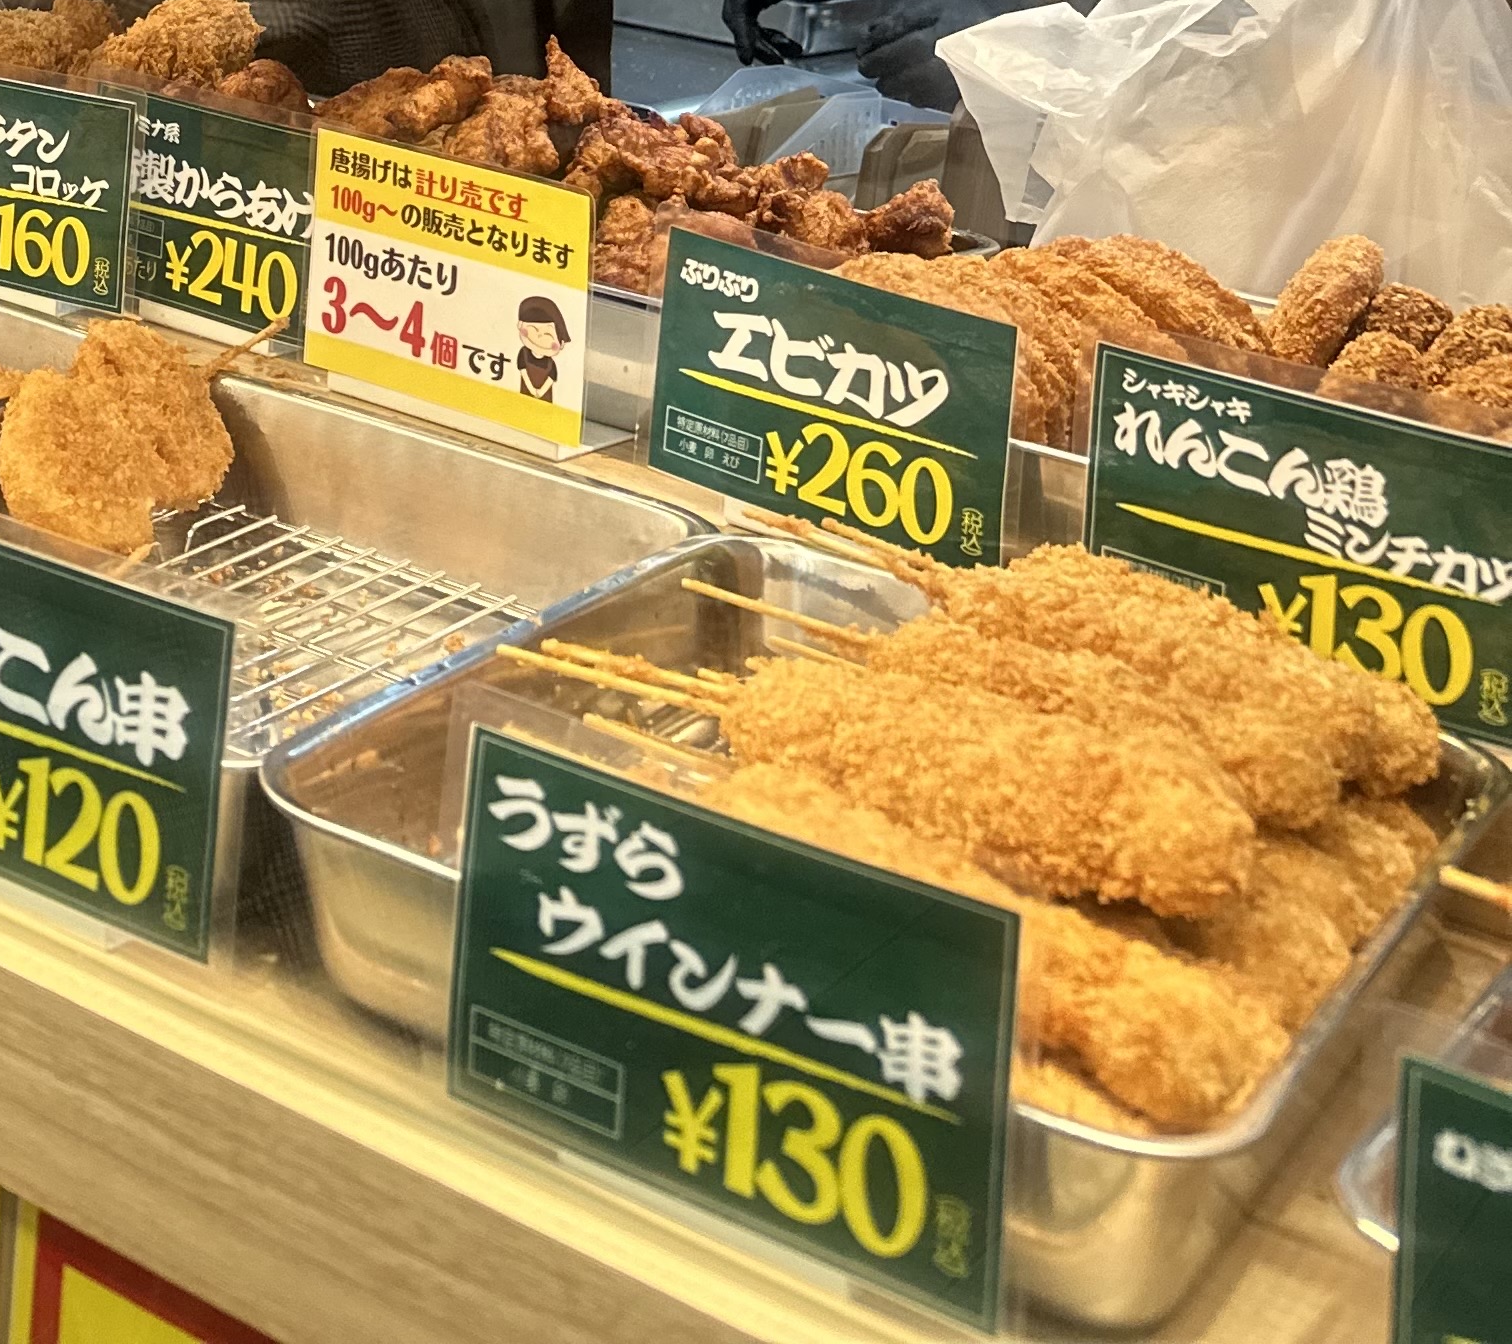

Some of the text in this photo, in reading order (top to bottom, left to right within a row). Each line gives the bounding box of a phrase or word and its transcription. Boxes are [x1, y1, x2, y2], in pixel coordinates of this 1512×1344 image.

[9, 163, 111, 208] コロッケ
[329, 146, 529, 220] 唐揚げは計り売です
[164, 229, 299, 322] ¥240
[324, 232, 459, 296] 100gあたり
[707, 309, 950, 428] エビカツ
[1121, 367, 1253, 425] シャキシャキ
[764, 422, 954, 546] ¥260
[1113, 400, 1391, 530] れんこん鶏
[1257, 573, 1475, 707] ¥130
[488, 774, 685, 901] うずら
[536, 886, 965, 1106] ウインナー串
[661, 1063, 929, 1258] ¥130
